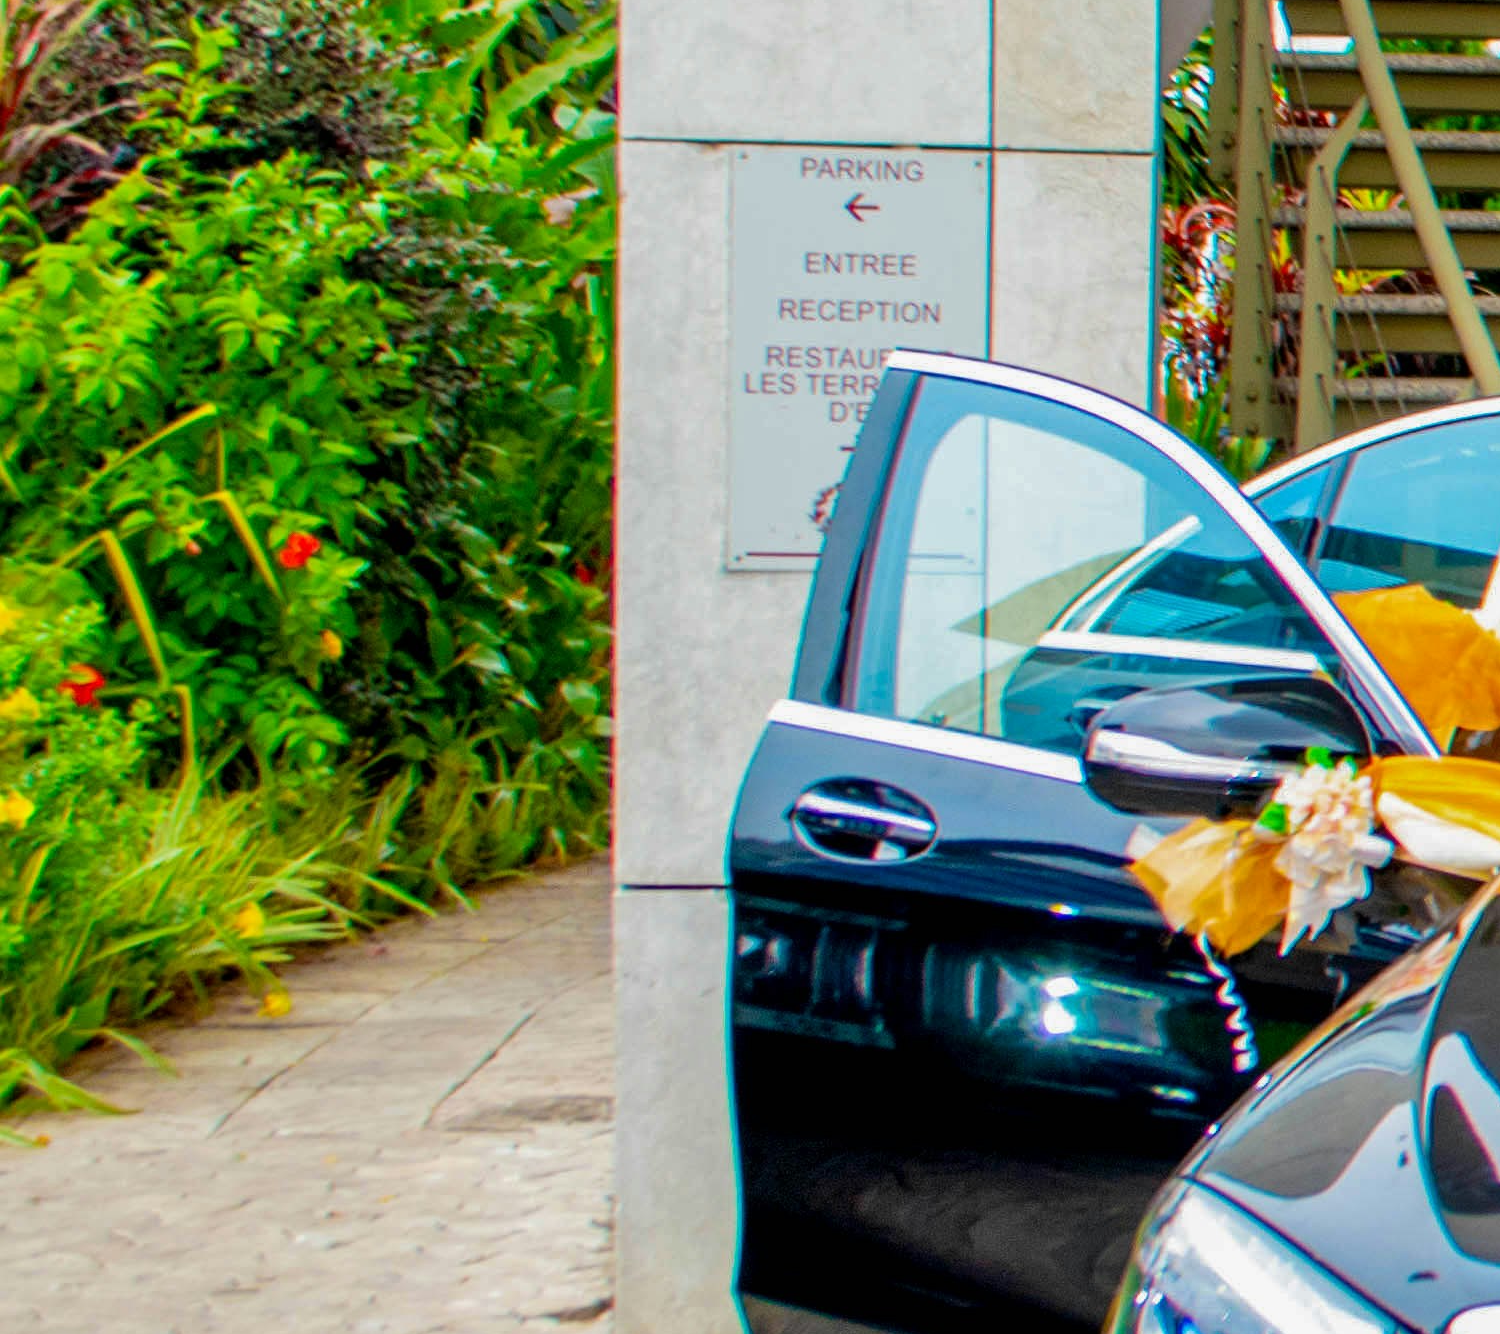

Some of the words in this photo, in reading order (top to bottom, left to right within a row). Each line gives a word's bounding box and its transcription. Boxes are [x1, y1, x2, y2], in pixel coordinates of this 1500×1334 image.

[801, 157, 925, 183] PARKING
[804, 251, 917, 277] ENTREE
[778, 298, 942, 324] RECEPTION
[744, 372, 797, 396] LES
